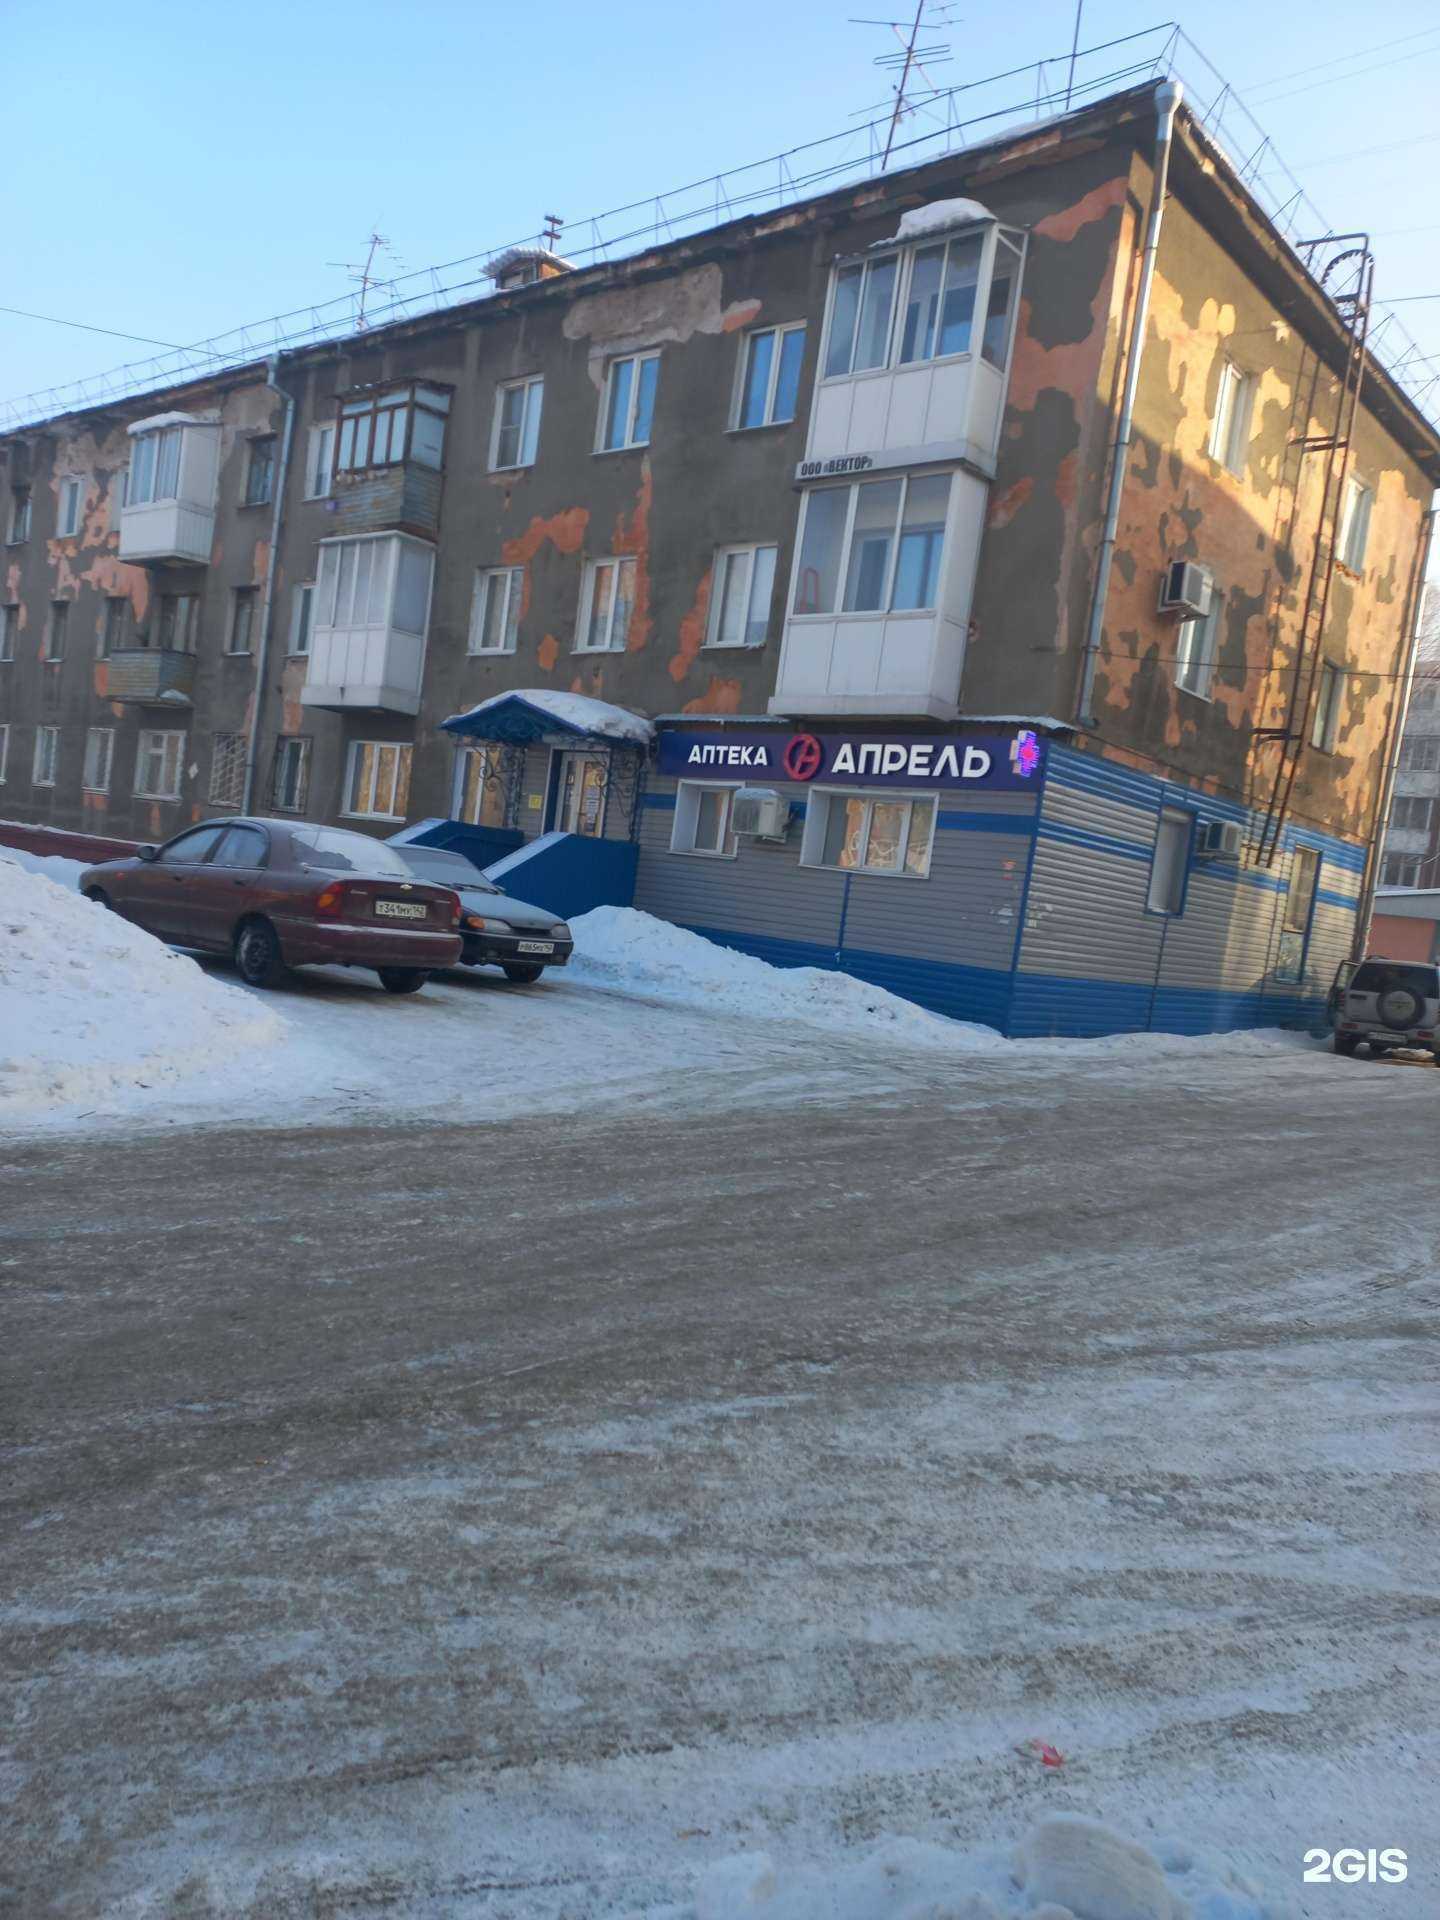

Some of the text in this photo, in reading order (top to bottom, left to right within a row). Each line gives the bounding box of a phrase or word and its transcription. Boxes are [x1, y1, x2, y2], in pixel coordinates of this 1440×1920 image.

[801, 461, 821, 475] ООО
[688, 744, 768, 766] АПТЕКА
[831, 743, 992, 778] АПРЕЛЬ
